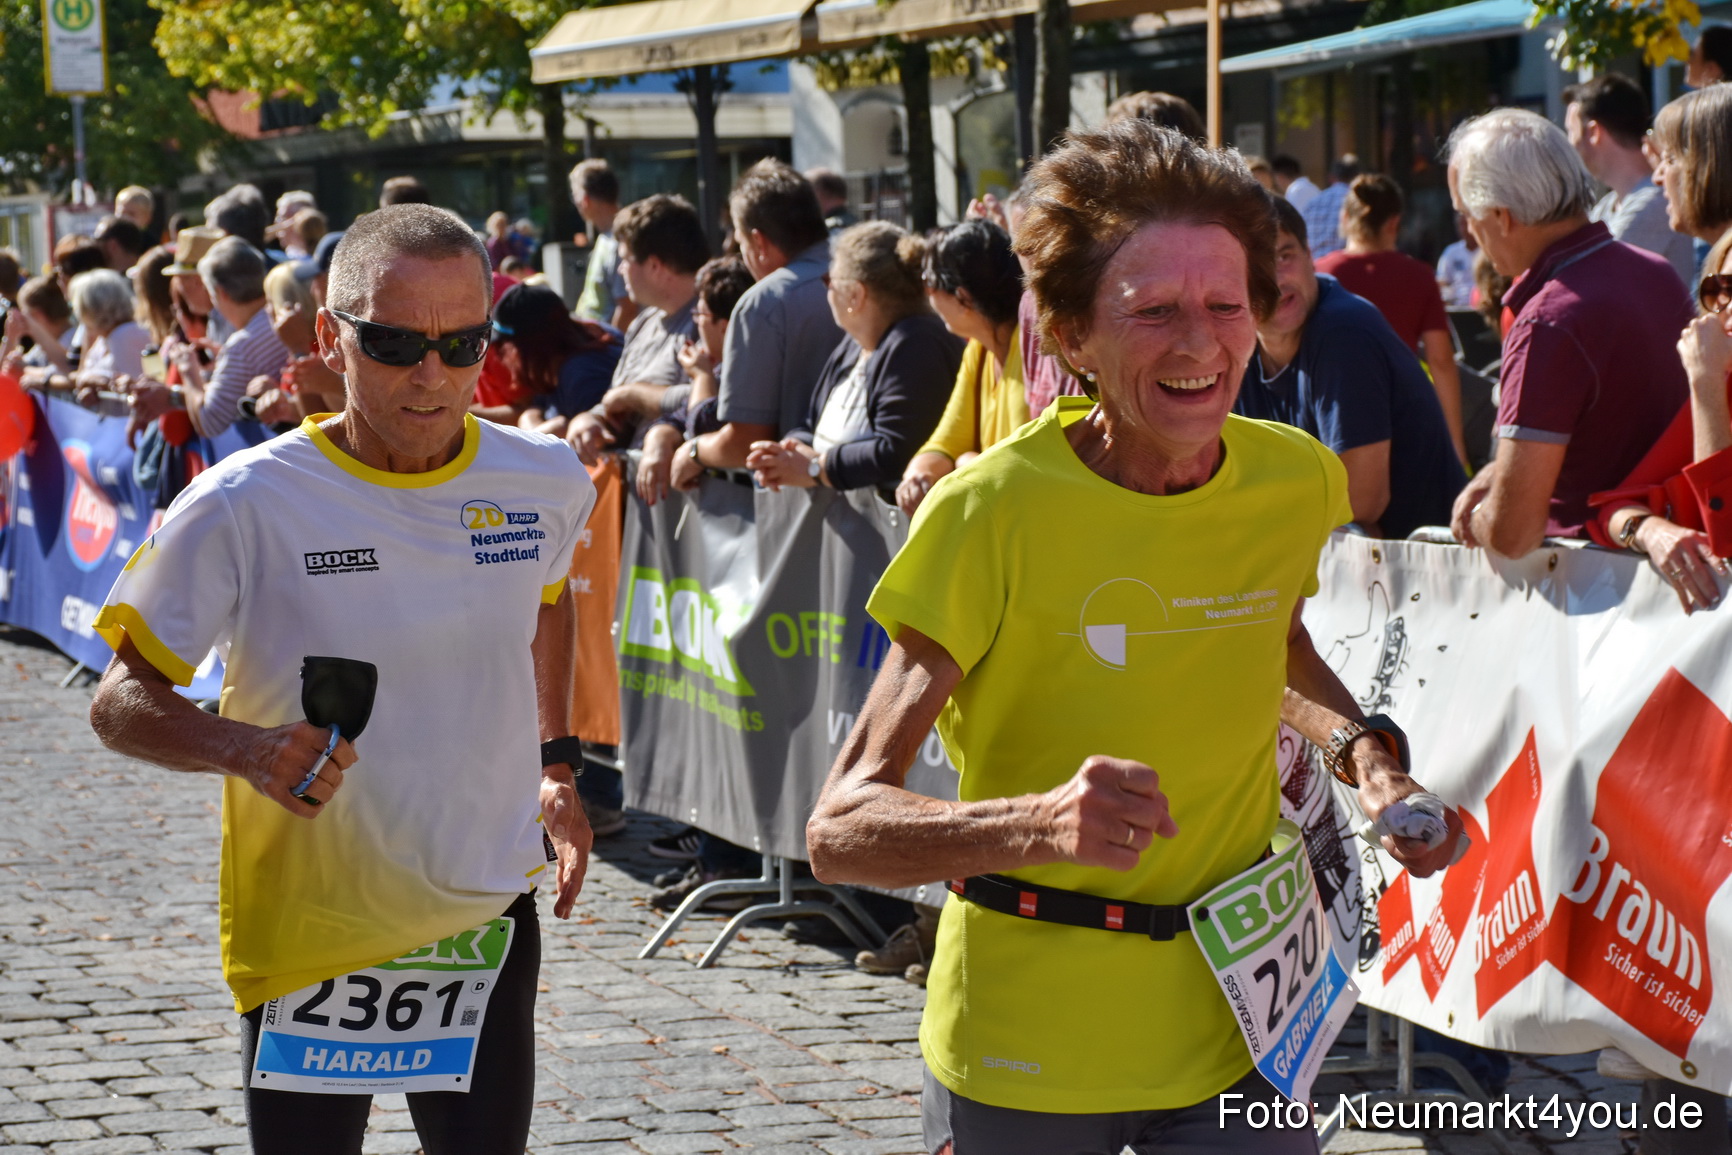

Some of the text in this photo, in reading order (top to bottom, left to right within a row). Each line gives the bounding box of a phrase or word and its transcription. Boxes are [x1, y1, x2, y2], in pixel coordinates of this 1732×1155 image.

[465, 506, 537, 530] 20 JAHRE
[304, 548, 378, 570] BOCK
[474, 544, 540, 565] Stadtlauf
[307, 568, 329, 577] inspired
[355, 565, 380, 573] concepts
[1172, 596, 1215, 608] Kliniken
[1217, 594, 1235, 604] des
[1205, 605, 1254, 619] Neumarkt
[1558, 821, 1702, 991] Braun
[1495, 947, 1521, 971] Sicher
[1603, 942, 1645, 984] Sicher
[1643, 972, 1665, 998] ist
[291, 975, 465, 1032] 2361
[302, 1046, 433, 1073] HARALD
[982, 1055, 1042, 1075] SPIRO
